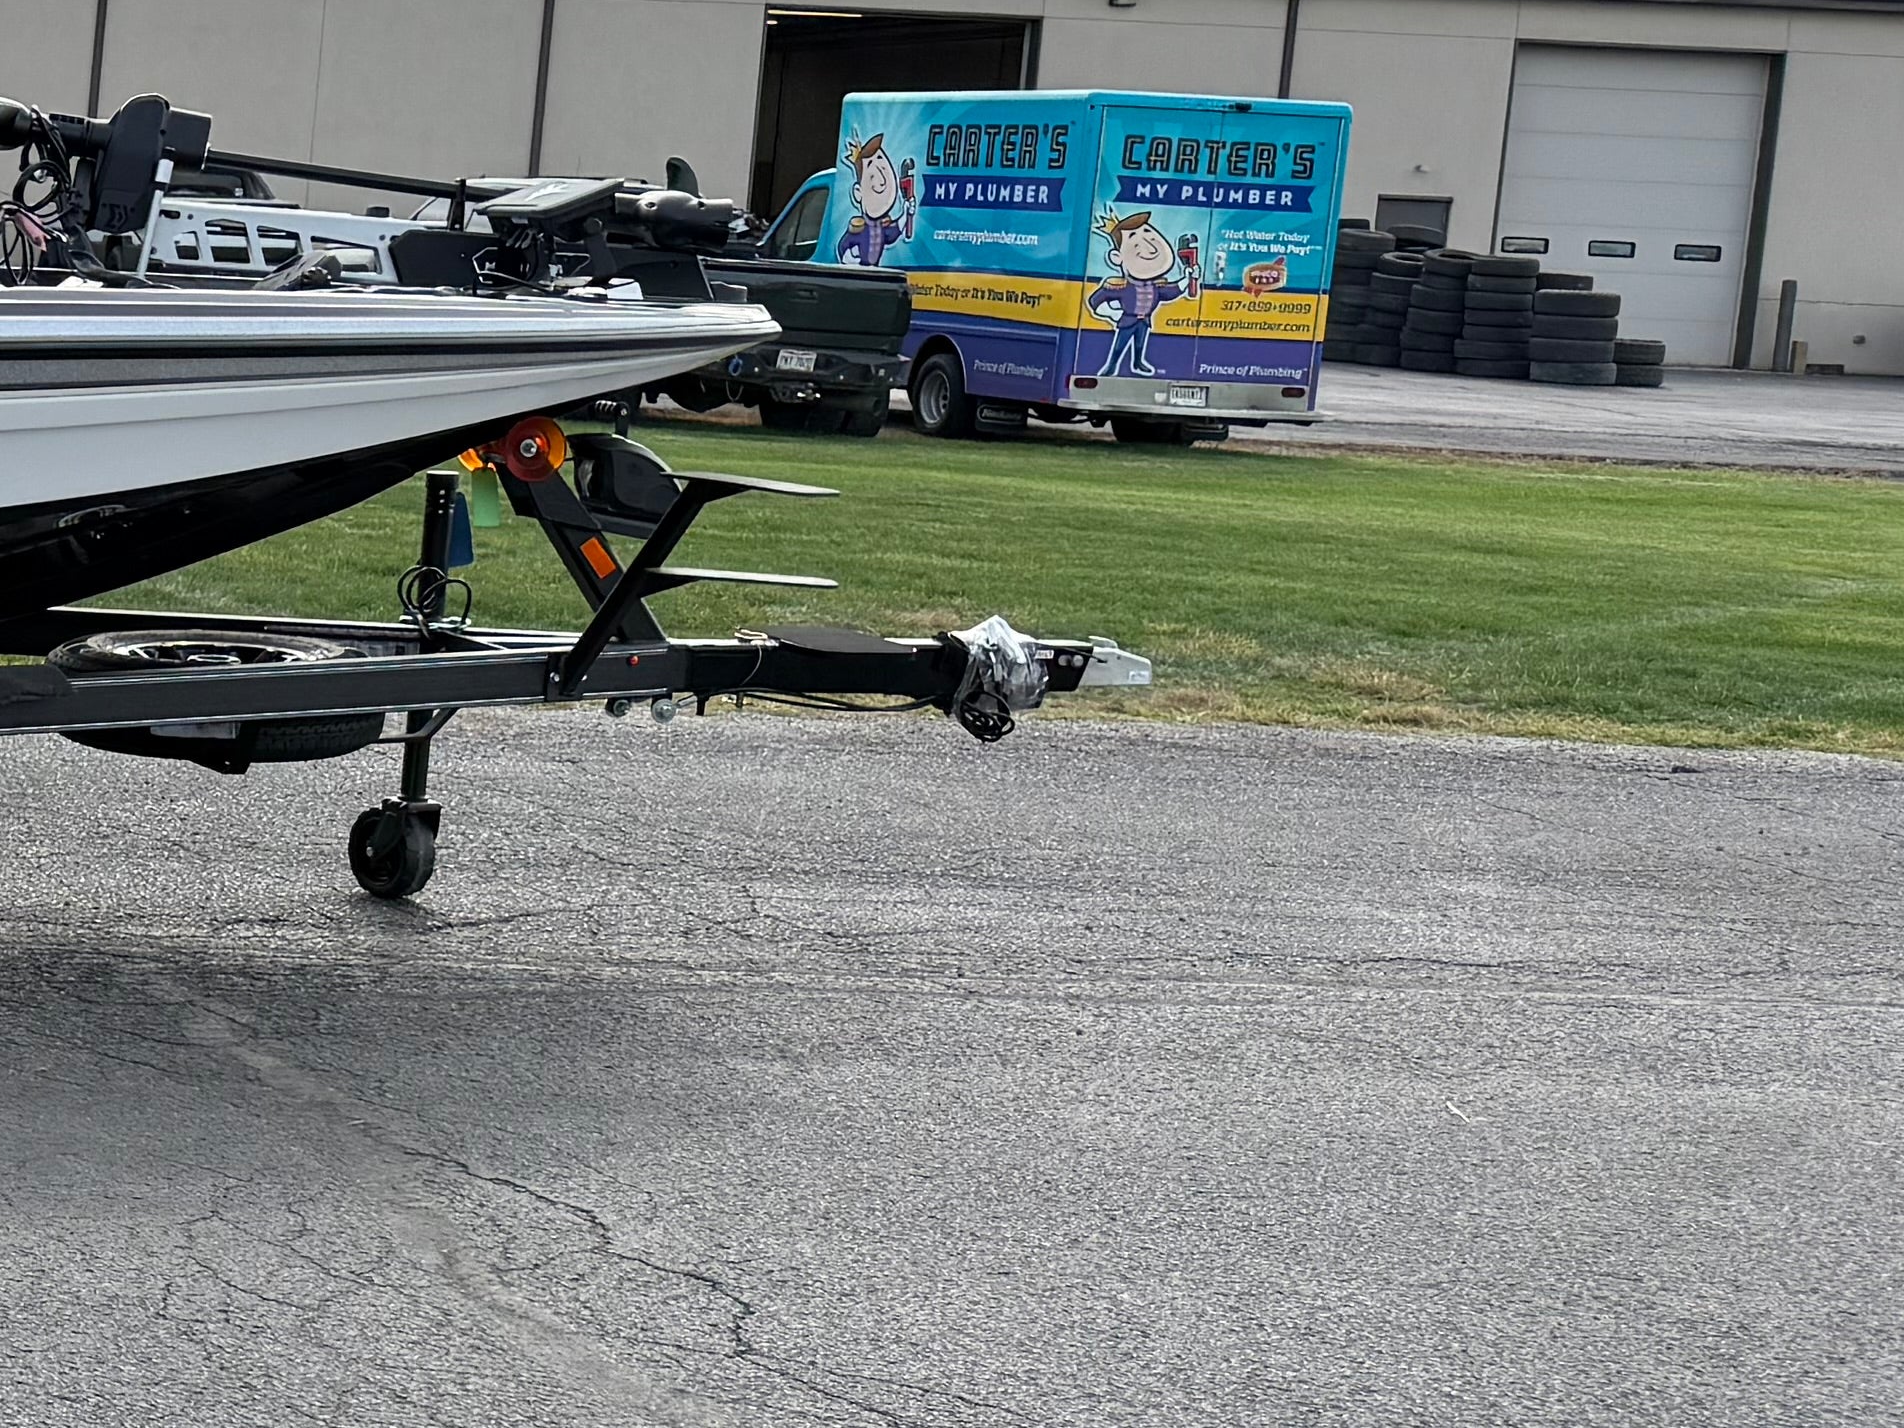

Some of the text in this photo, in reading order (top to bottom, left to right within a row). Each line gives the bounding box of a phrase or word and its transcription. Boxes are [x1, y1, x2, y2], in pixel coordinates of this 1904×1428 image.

[926, 124, 1069, 170] CARTER'S
[1122, 134, 1316, 180] CARTER'S
[935, 182, 1049, 204] MY PLUMBER
[1135, 183, 1293, 206] MY PLUMBER
[1199, 363, 1303, 380] Prince of Plumbing
